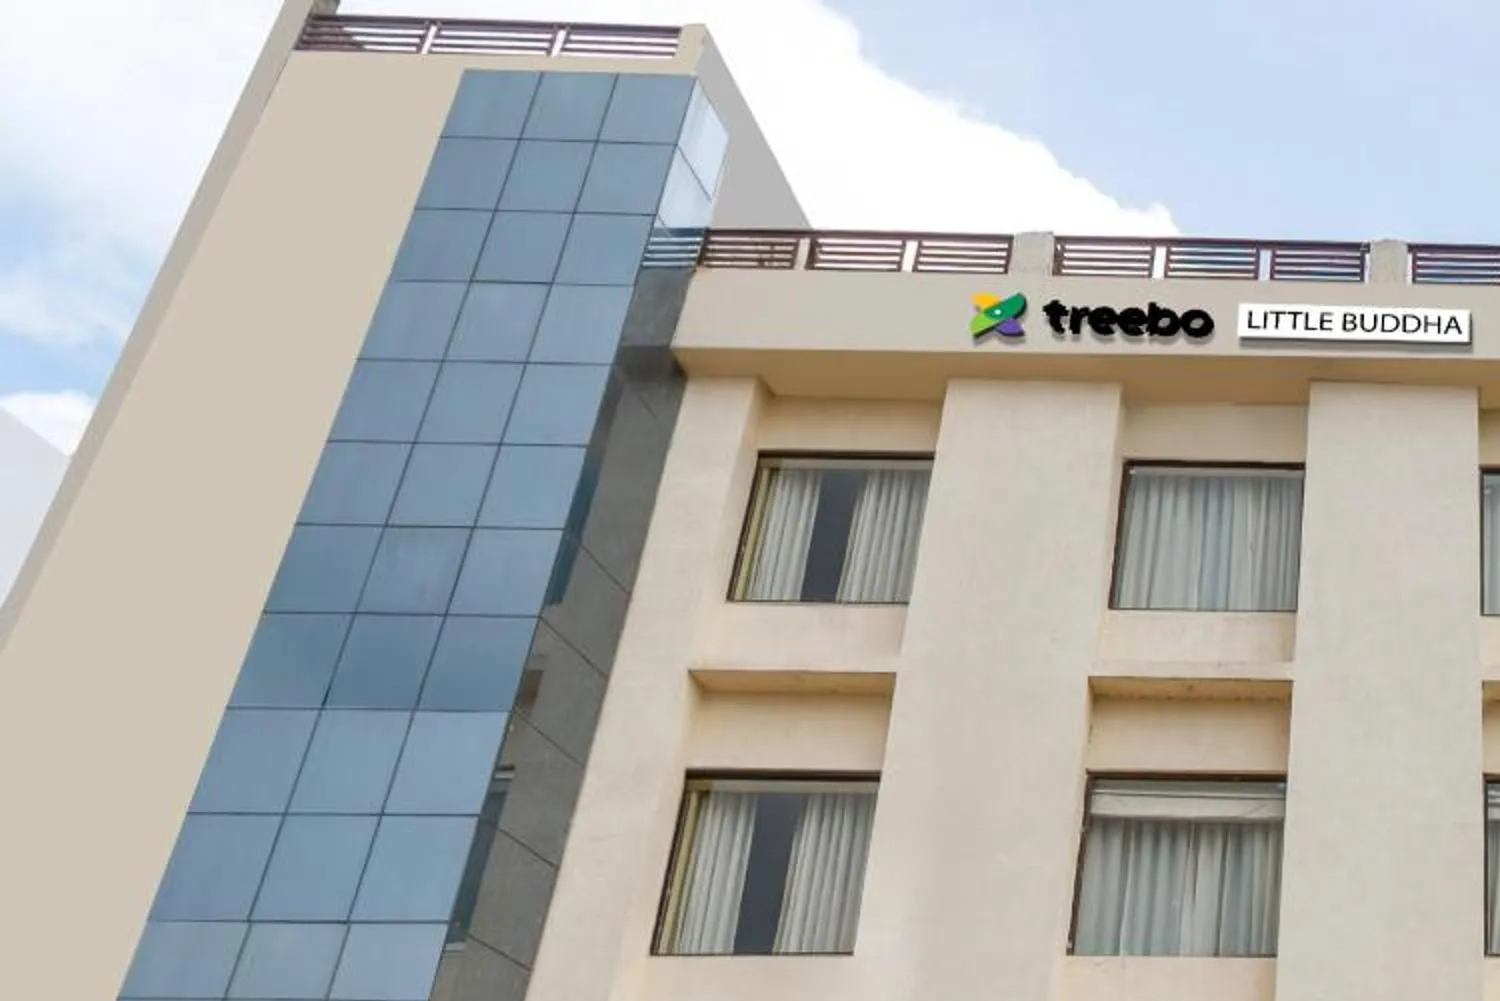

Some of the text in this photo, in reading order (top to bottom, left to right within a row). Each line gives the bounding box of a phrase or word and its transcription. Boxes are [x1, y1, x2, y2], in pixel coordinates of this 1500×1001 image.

[1043, 299, 1214, 339] treebo
[1247, 310, 1462, 335] LITTLE BUDDHA
